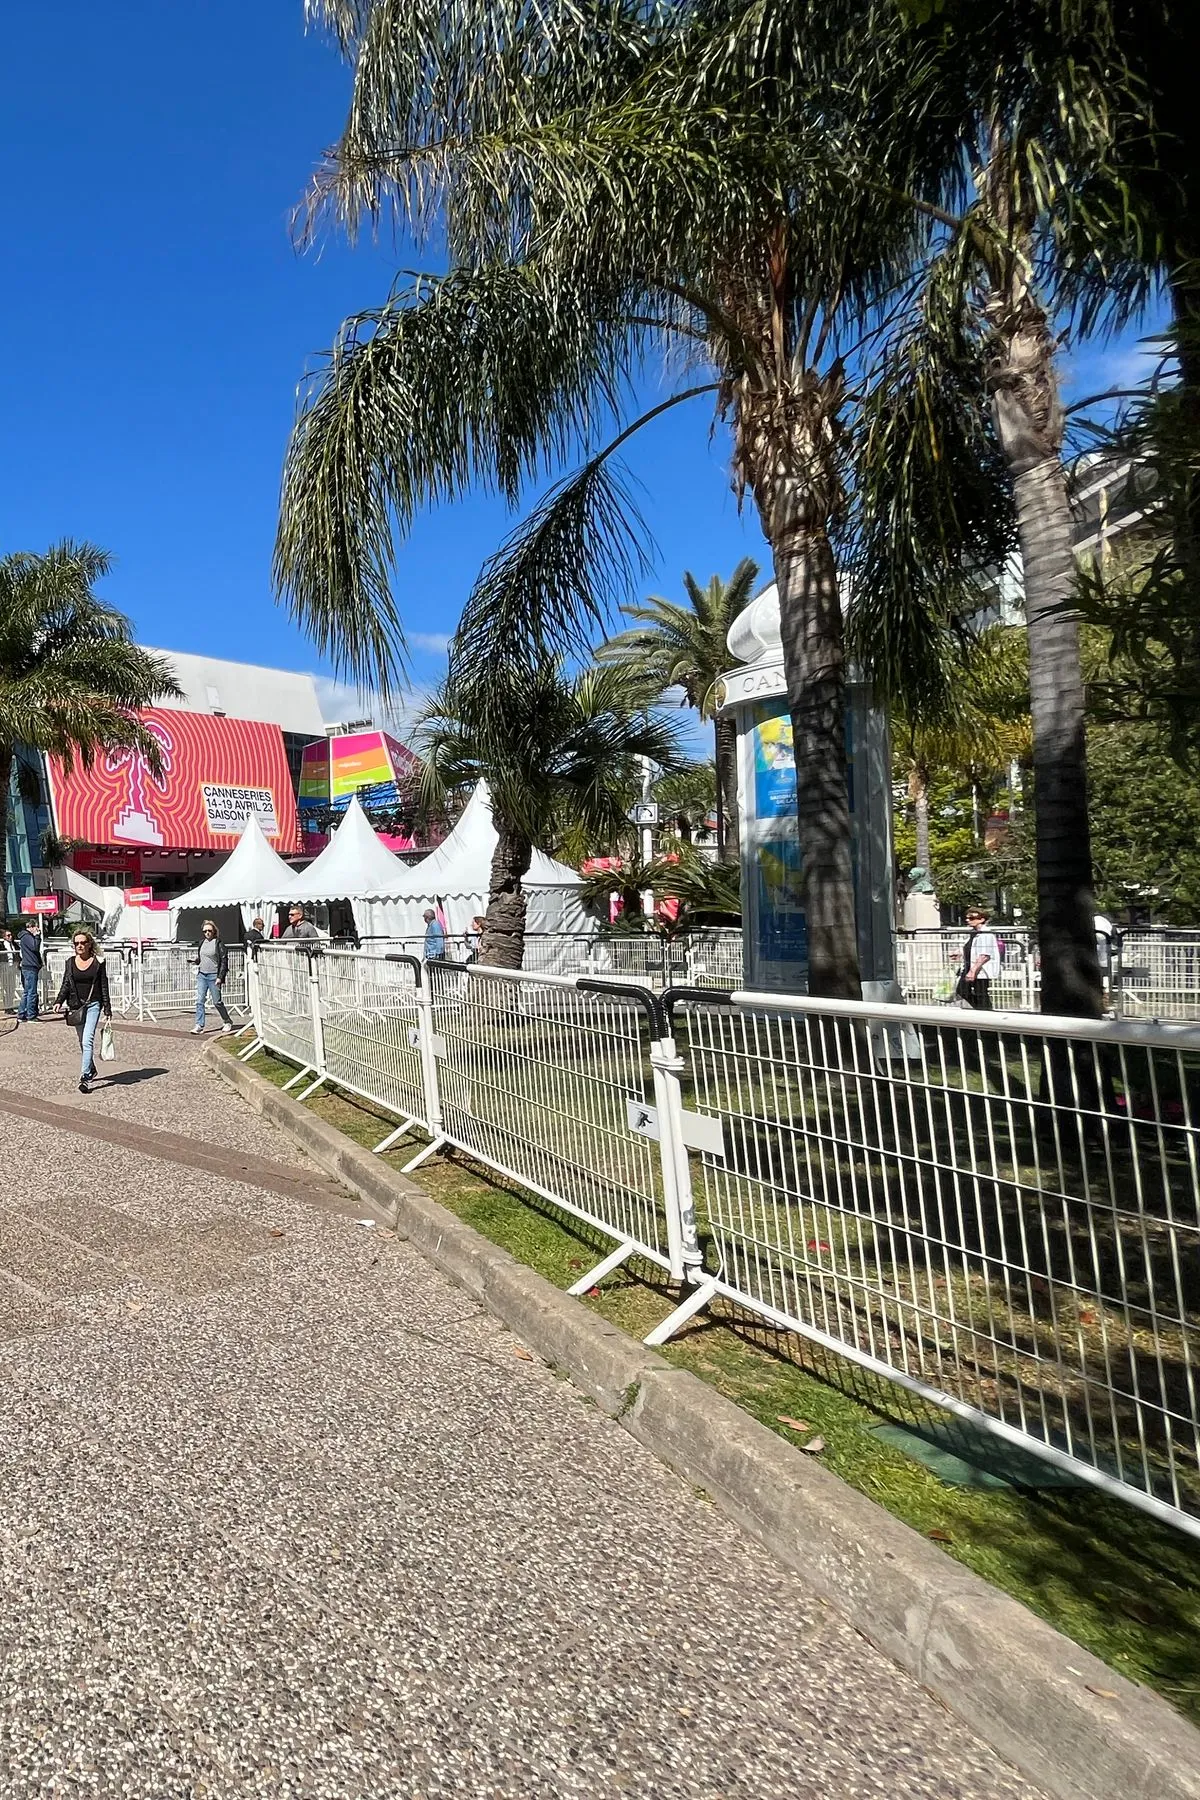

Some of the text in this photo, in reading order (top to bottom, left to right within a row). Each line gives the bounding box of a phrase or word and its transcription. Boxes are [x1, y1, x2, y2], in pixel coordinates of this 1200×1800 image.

[203, 786, 272, 802] CANNESERIES
[206, 798, 274, 812] 14-19 AVRIL 23
[208, 809, 245, 821] SAISON
